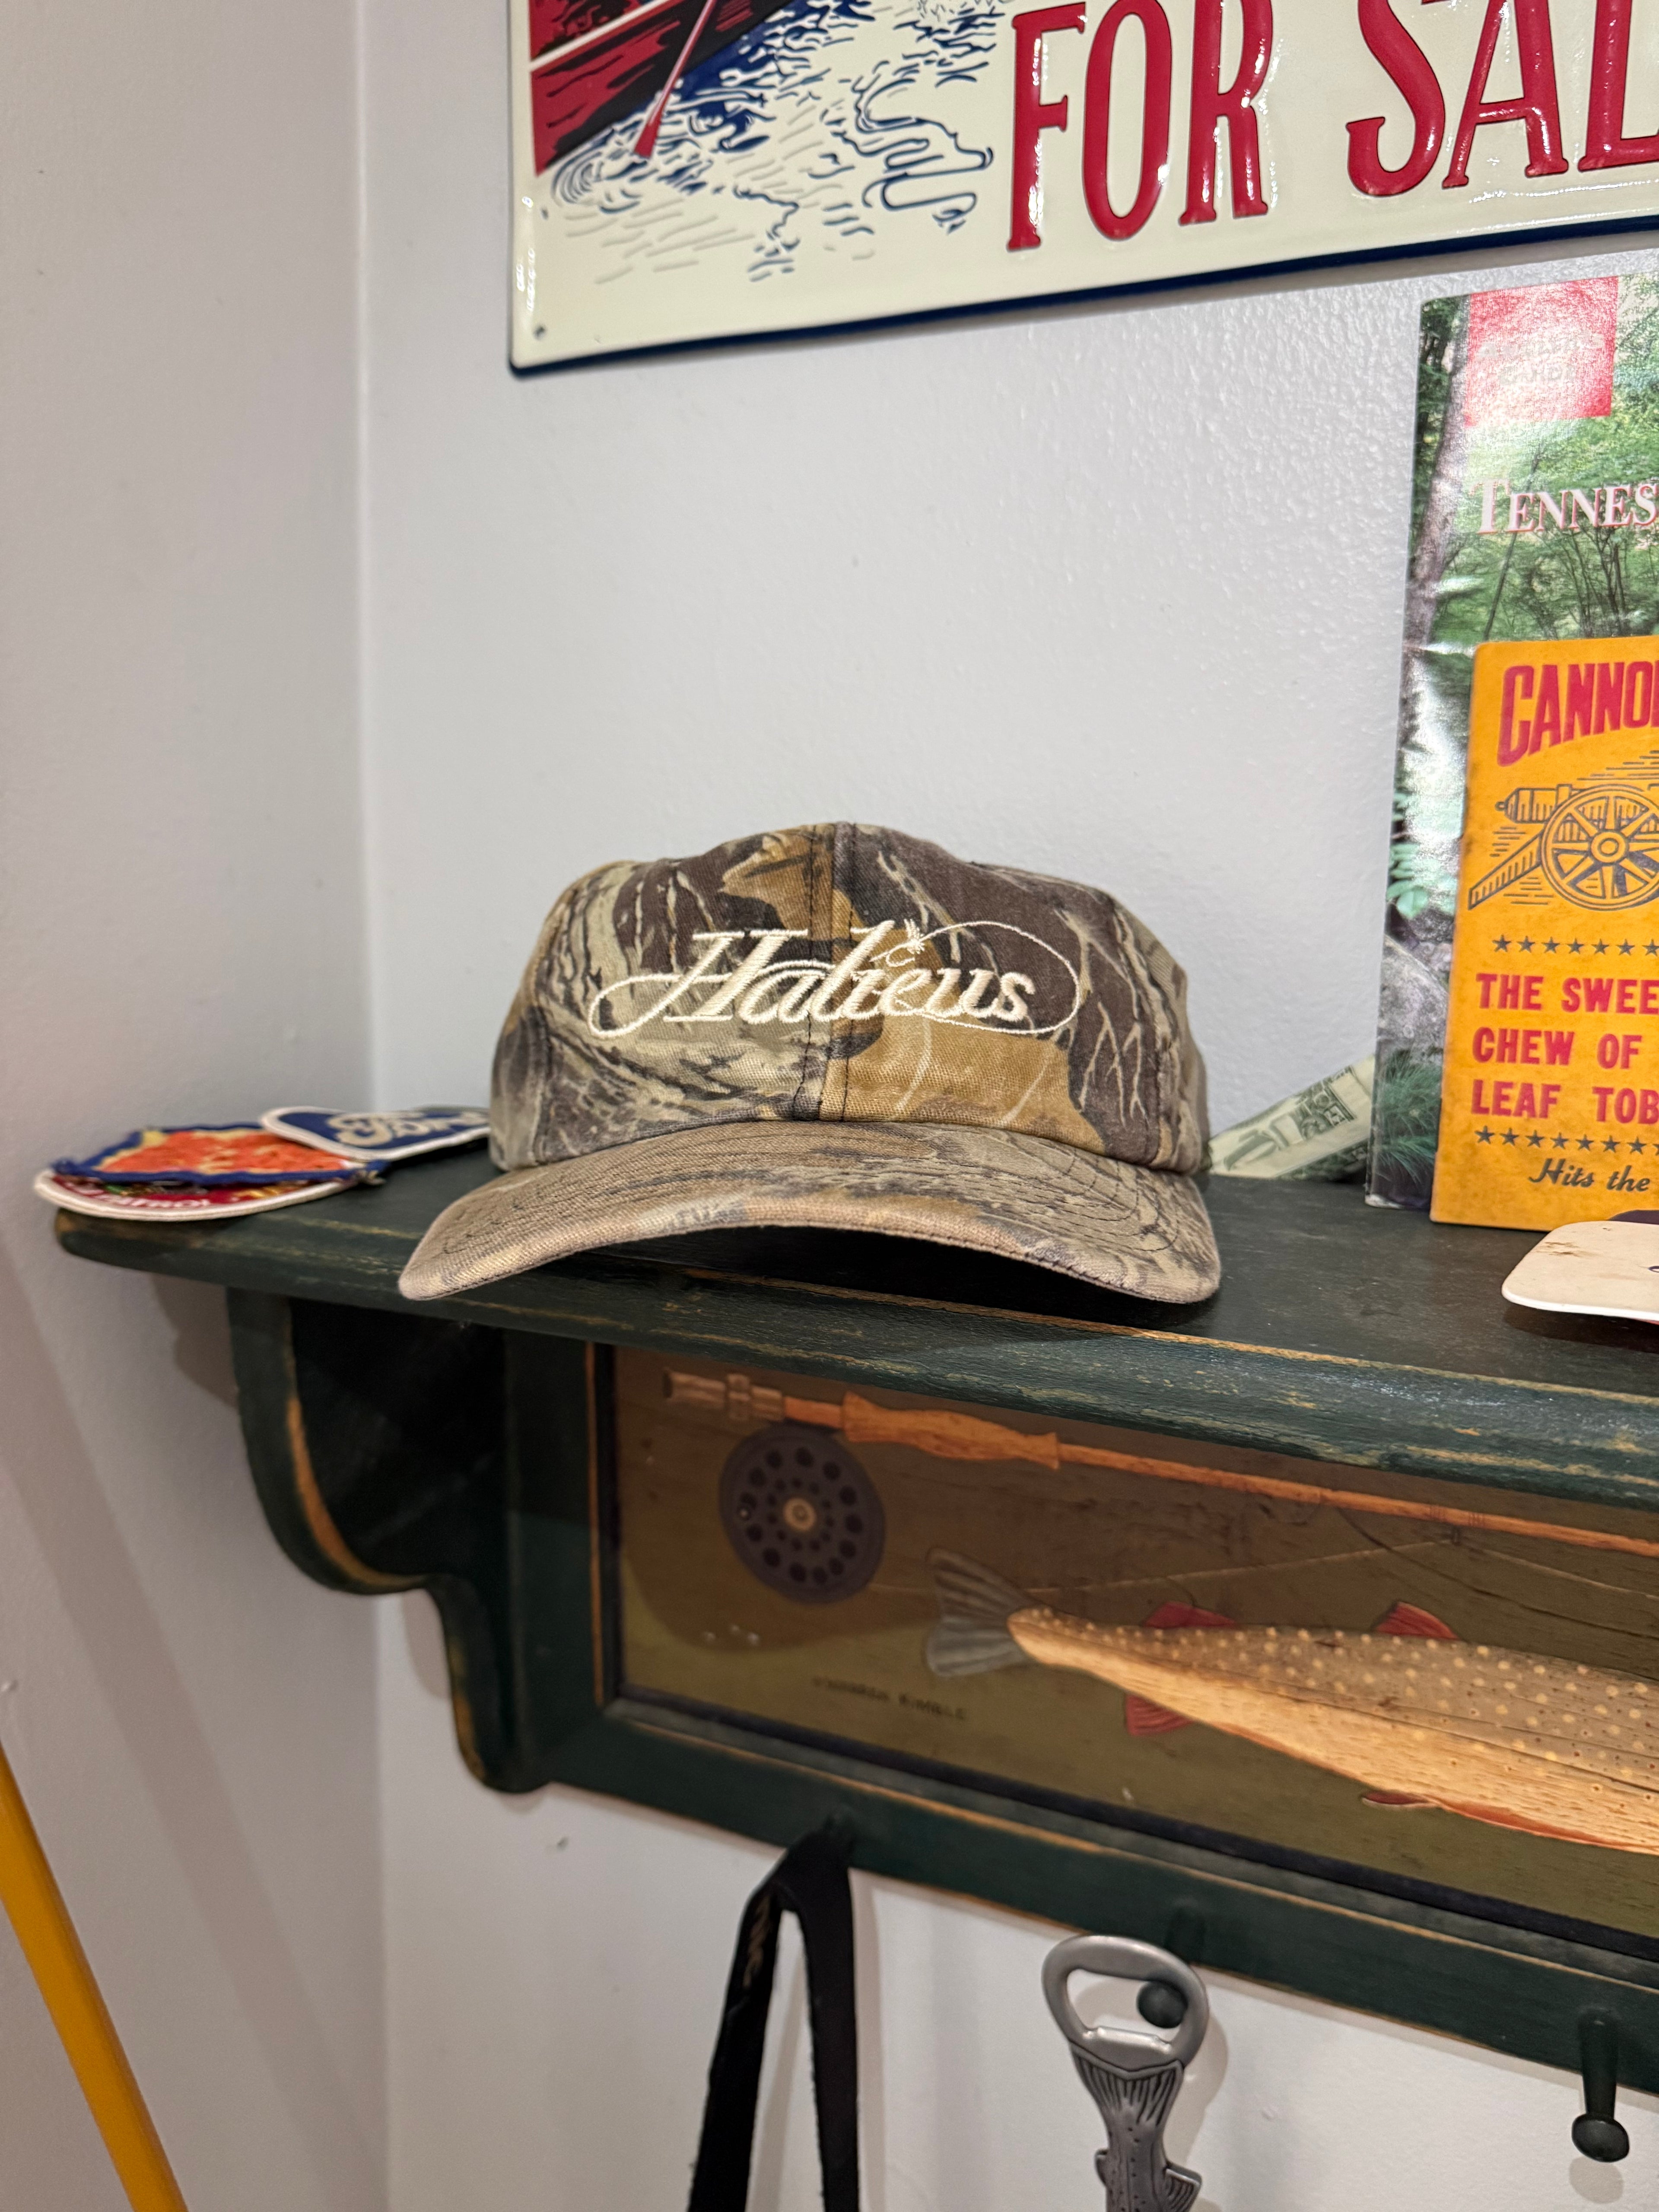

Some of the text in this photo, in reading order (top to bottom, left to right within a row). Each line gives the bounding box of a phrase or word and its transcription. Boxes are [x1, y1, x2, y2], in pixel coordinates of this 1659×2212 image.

[1006, 0, 1272, 252] FOR
[588, 918, 1079, 1037] Halieus
[1475, 973, 1659, 1015] THE SWEE
[1472, 1027, 1642, 1070] CHEW OF
[1471, 1079, 1659, 1124] LEAF TOB
[1529, 1157, 1650, 1192] Hits the
